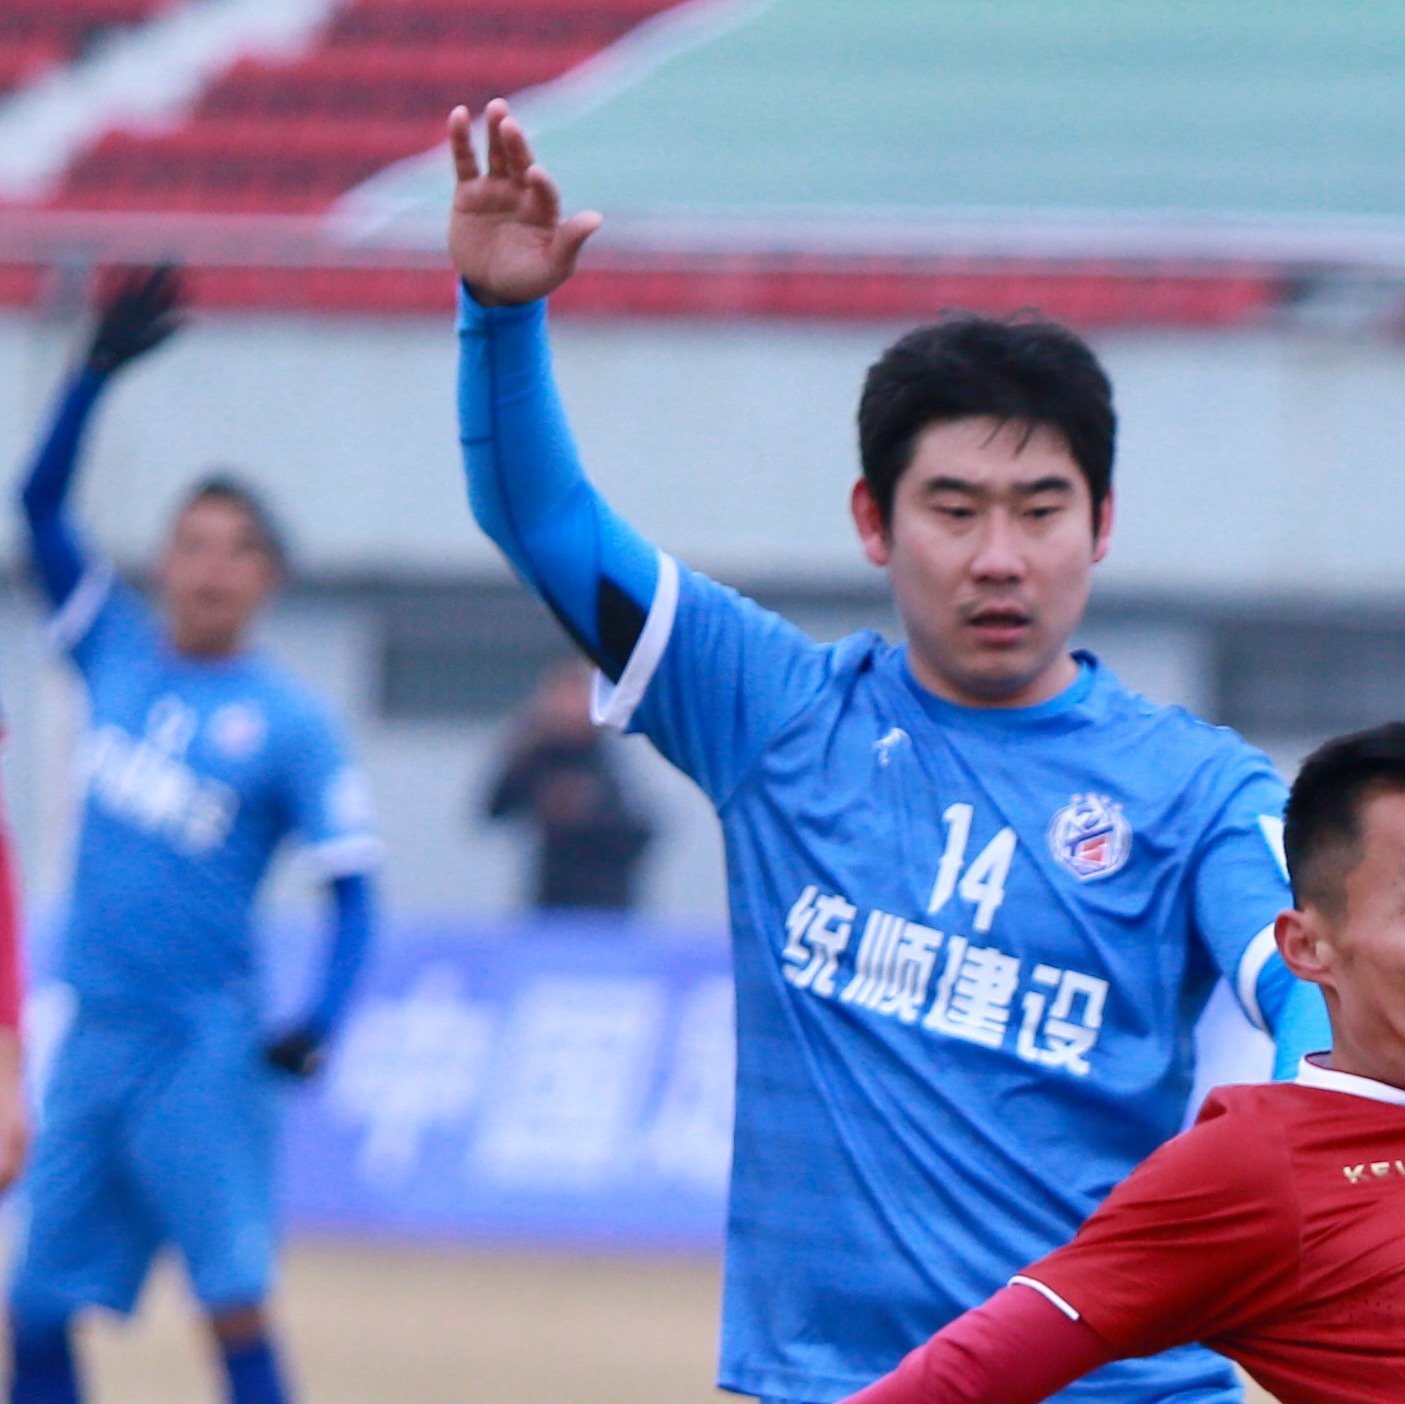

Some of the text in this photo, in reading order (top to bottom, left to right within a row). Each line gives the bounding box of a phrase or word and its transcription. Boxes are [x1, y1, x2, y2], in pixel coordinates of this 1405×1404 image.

[927, 800, 1018, 933] 14
[780, 884, 1109, 1075] 统顺建设
